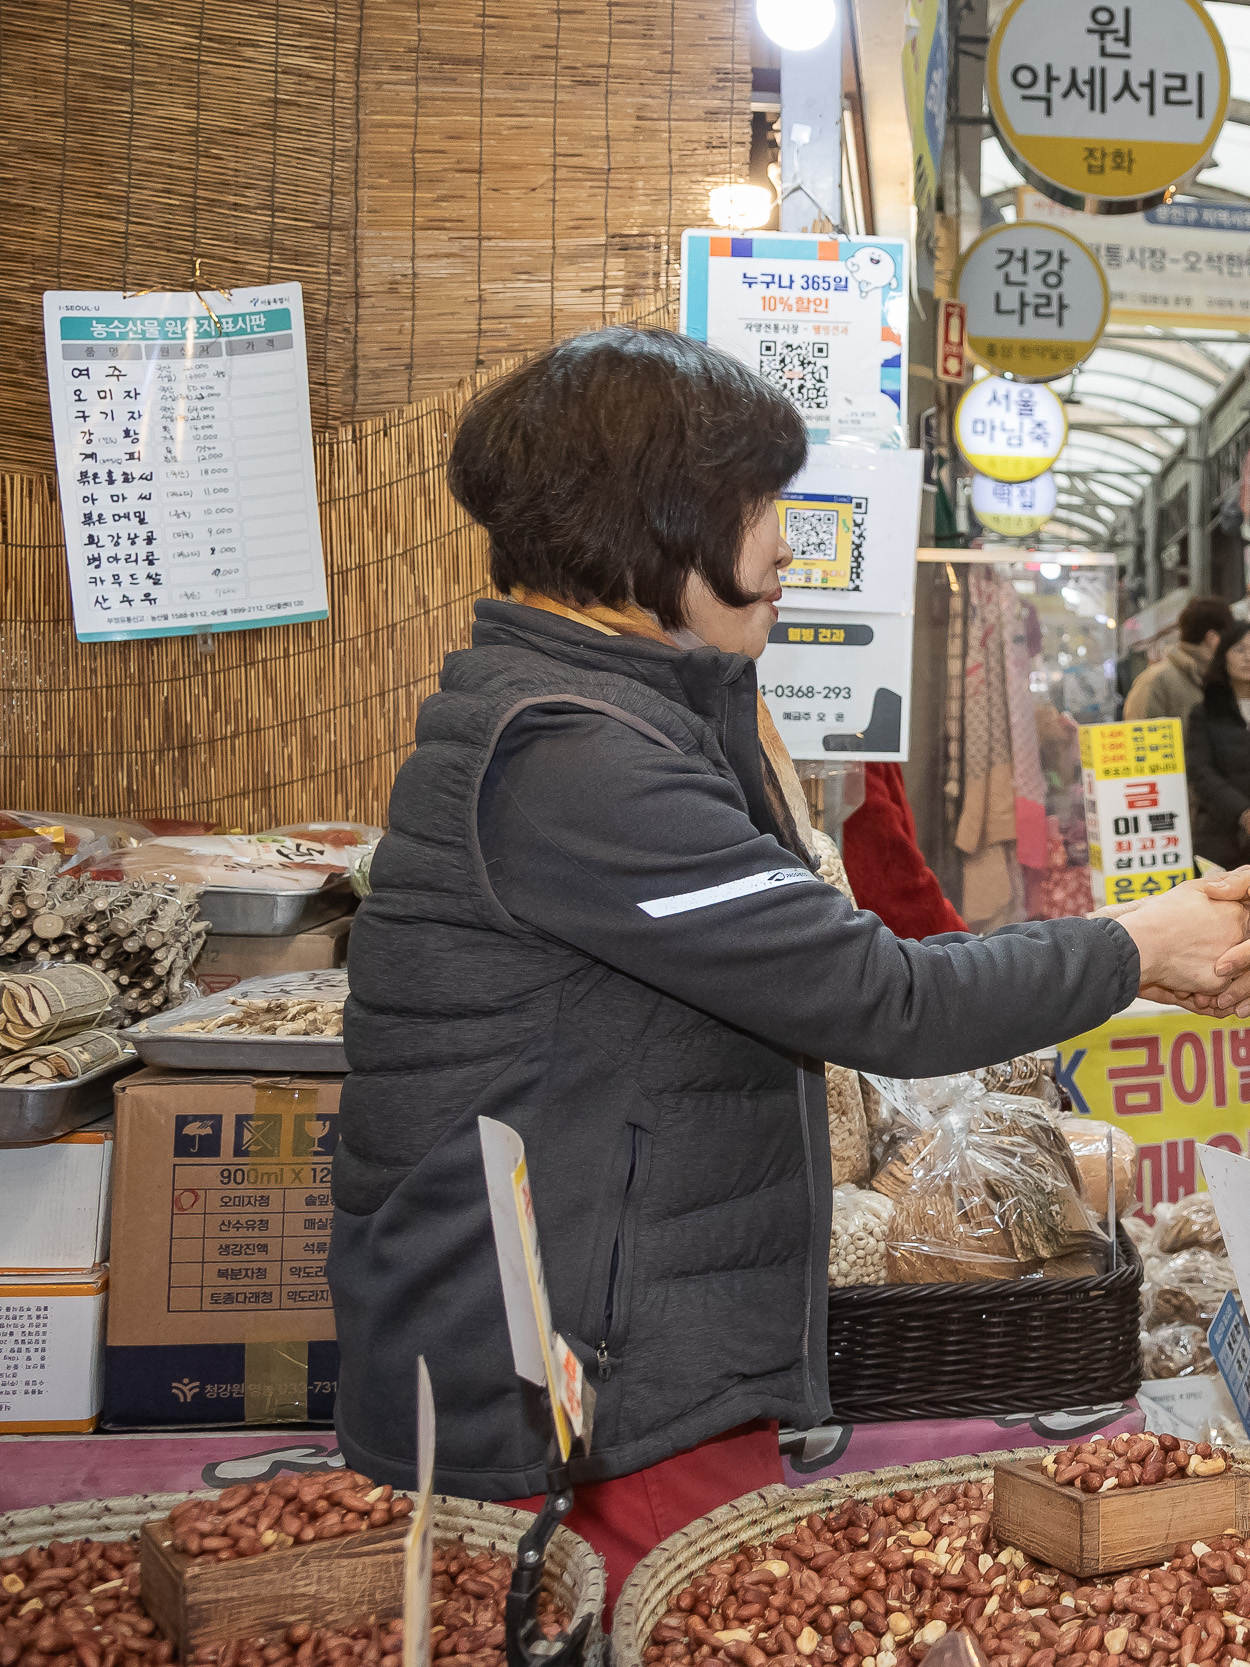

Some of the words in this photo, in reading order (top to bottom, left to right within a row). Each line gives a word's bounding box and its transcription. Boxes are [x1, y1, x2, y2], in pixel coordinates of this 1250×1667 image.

[1086, 6, 1132, 60] 원
[1010, 62, 1205, 120] 악세서리
[1082, 146, 1136, 176] 잡화
[994, 246, 1071, 290] 건강
[741, 272, 795, 290] 누구나
[800, 274, 849, 292] 365일
[993, 290, 1071, 329] 나라
[90, 319, 161, 338] 농수산물
[165, 318, 216, 337] 원산지
[220, 313, 266, 332] 표시판
[1124, 781, 1159, 810] 금
[219, 1194, 271, 1208] 오미자청
[218, 1218, 270, 1232] 산수유청
[217, 1243, 269, 1257] 생강진액
[216, 1267, 267, 1281] 복분자청
[209, 1291, 273, 1306] 토종다래청
[204, 1382, 245, 1399] 청강원
